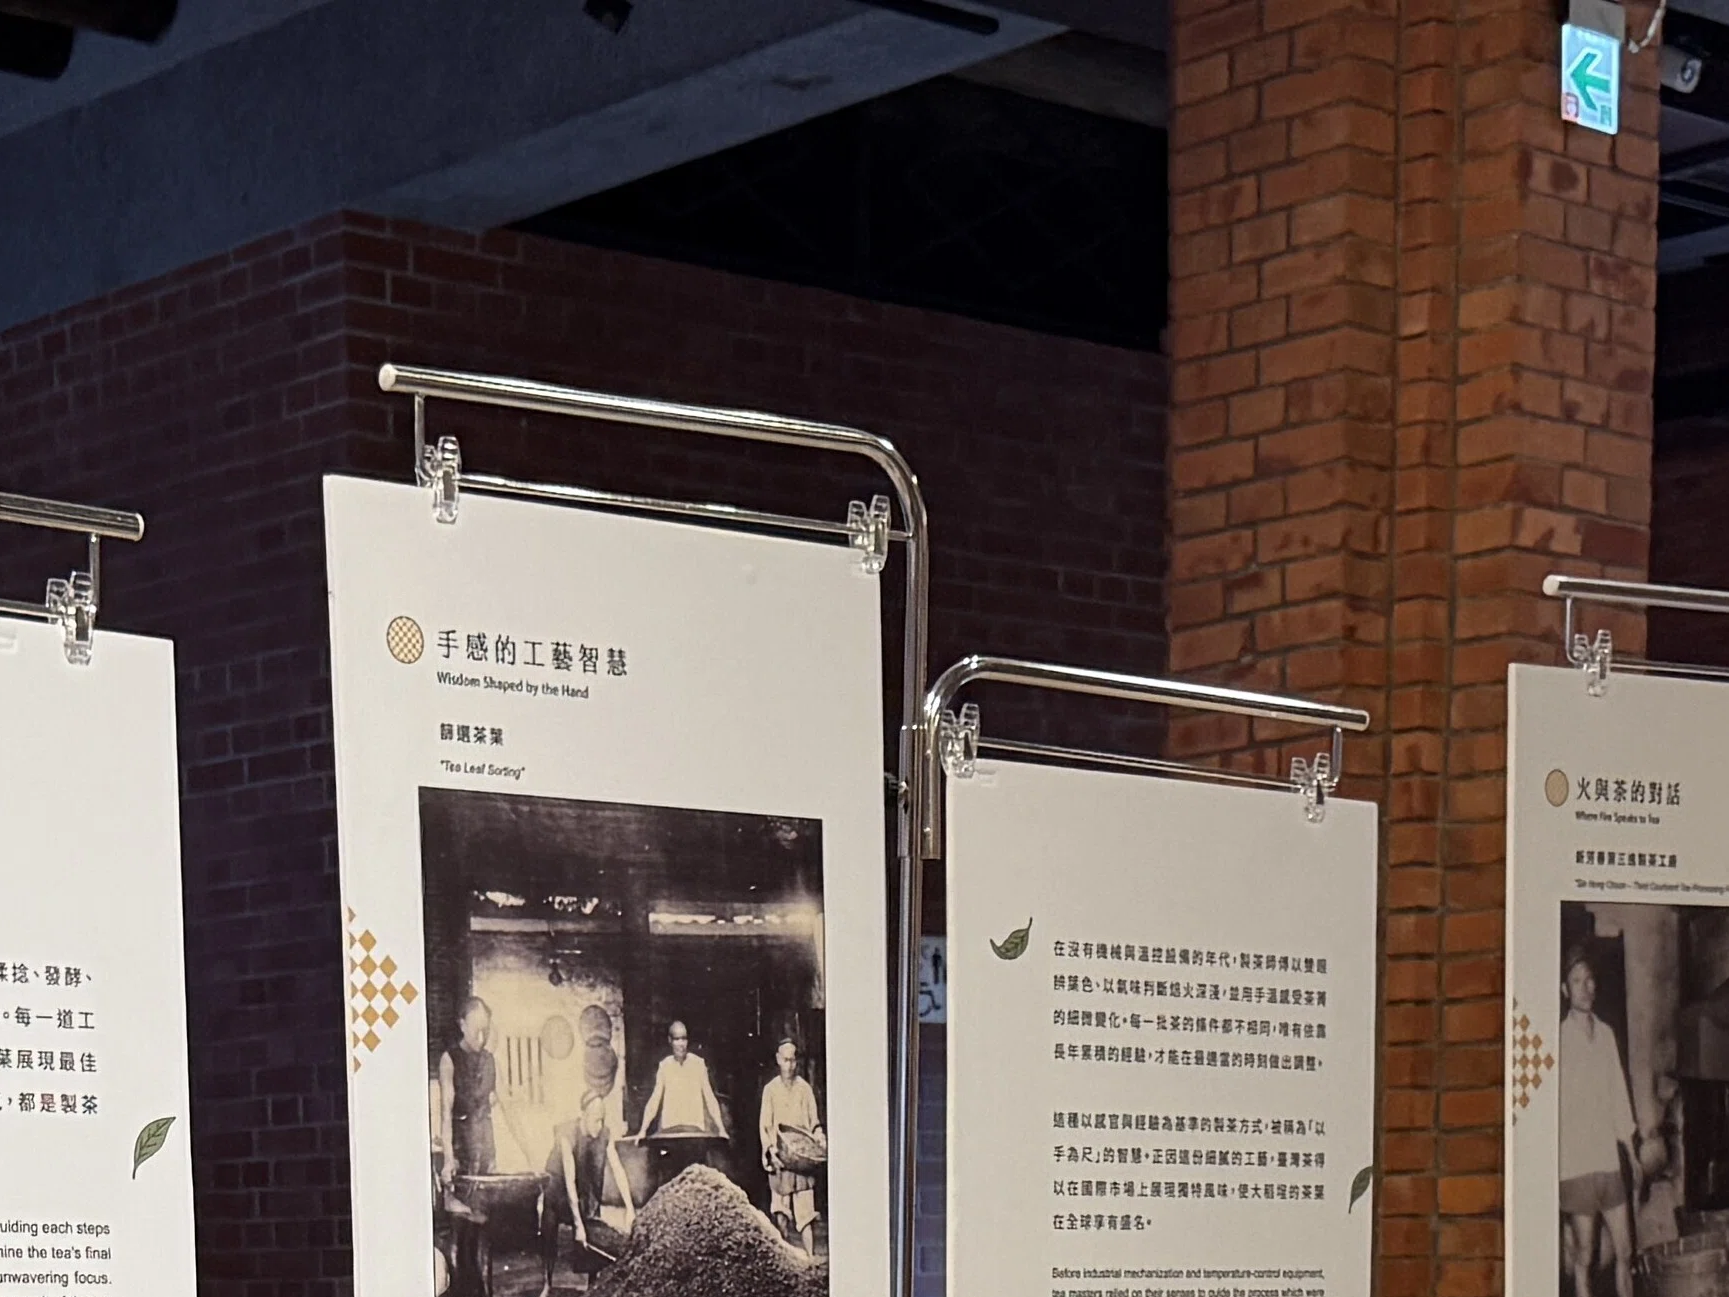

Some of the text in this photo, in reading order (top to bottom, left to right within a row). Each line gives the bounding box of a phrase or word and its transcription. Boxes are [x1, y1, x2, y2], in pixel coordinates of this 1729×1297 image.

[436, 629, 627, 676] 手感的工藝智慧
[436, 671, 589, 698] Wisdom Shaped by the Hand
[463, 761, 485, 774] Leaf
[1576, 776, 1680, 806] 火與茶的對話
[40, 1220, 73, 1235] each
[75, 1221, 111, 1238] steps
[26, 1243, 48, 1259] the
[84, 1244, 112, 1260] final
[73, 1269, 112, 1285] focus.
